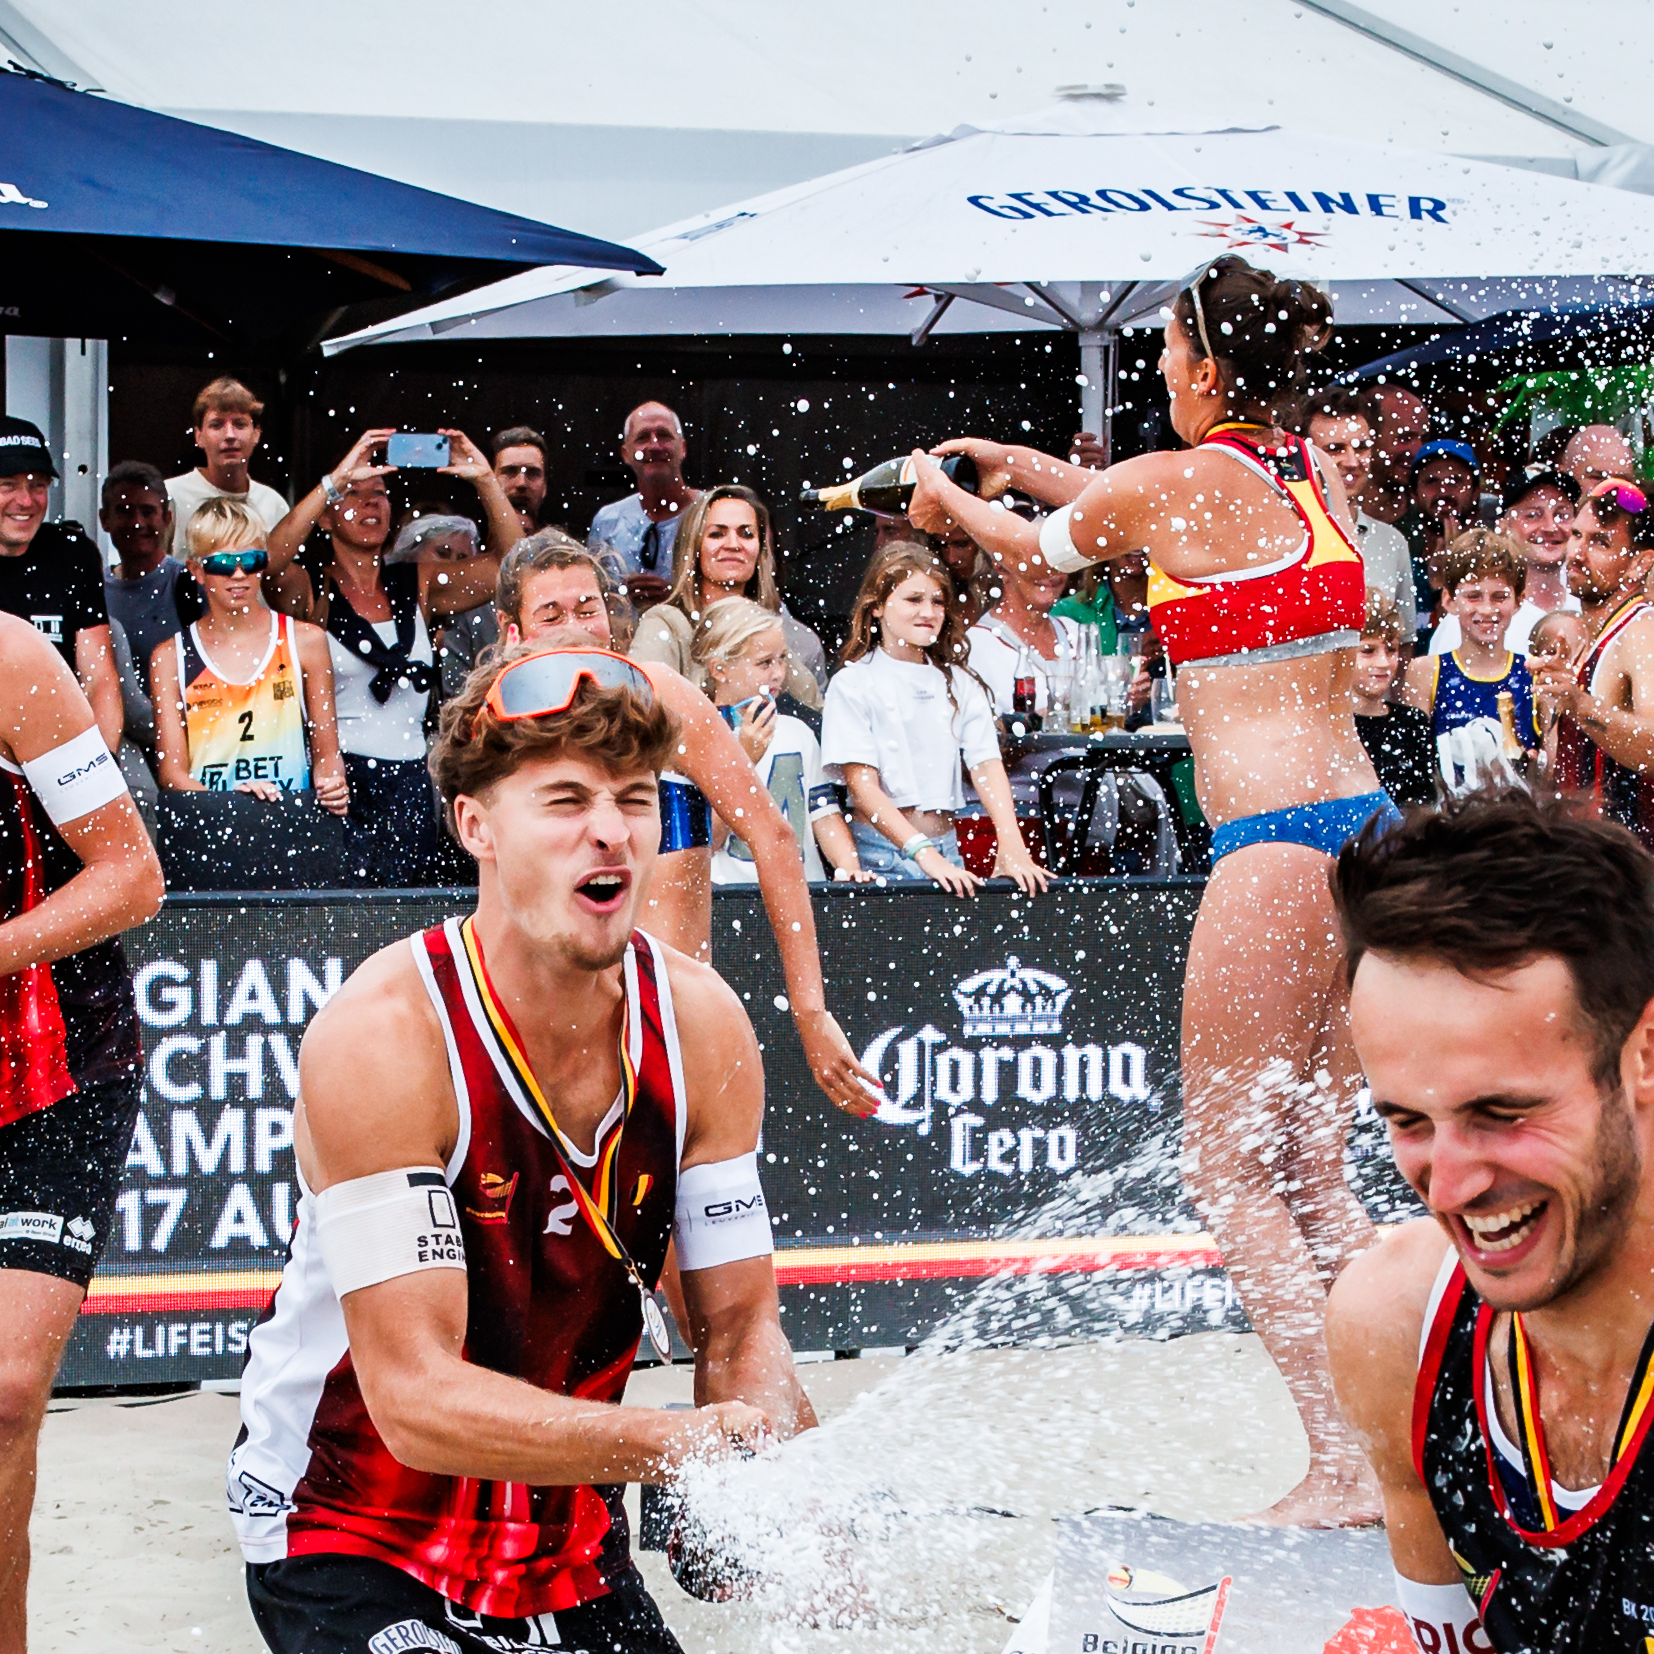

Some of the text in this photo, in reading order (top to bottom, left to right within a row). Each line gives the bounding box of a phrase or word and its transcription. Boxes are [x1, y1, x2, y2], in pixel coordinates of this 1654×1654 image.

[966, 186, 1450, 224] GEROLSTEINER
[238, 710, 254, 742] 2
[57, 752, 109, 786] GMS
[235, 755, 283, 780] BET
[134, 957, 344, 1028] GIAN
[855, 1023, 1151, 1136] Corona
[950, 1112, 1079, 1177] Cero
[116, 1186, 188, 1252] 17
[542, 1174, 580, 1236] 2
[106, 1321, 248, 1359] #LIFEIS
